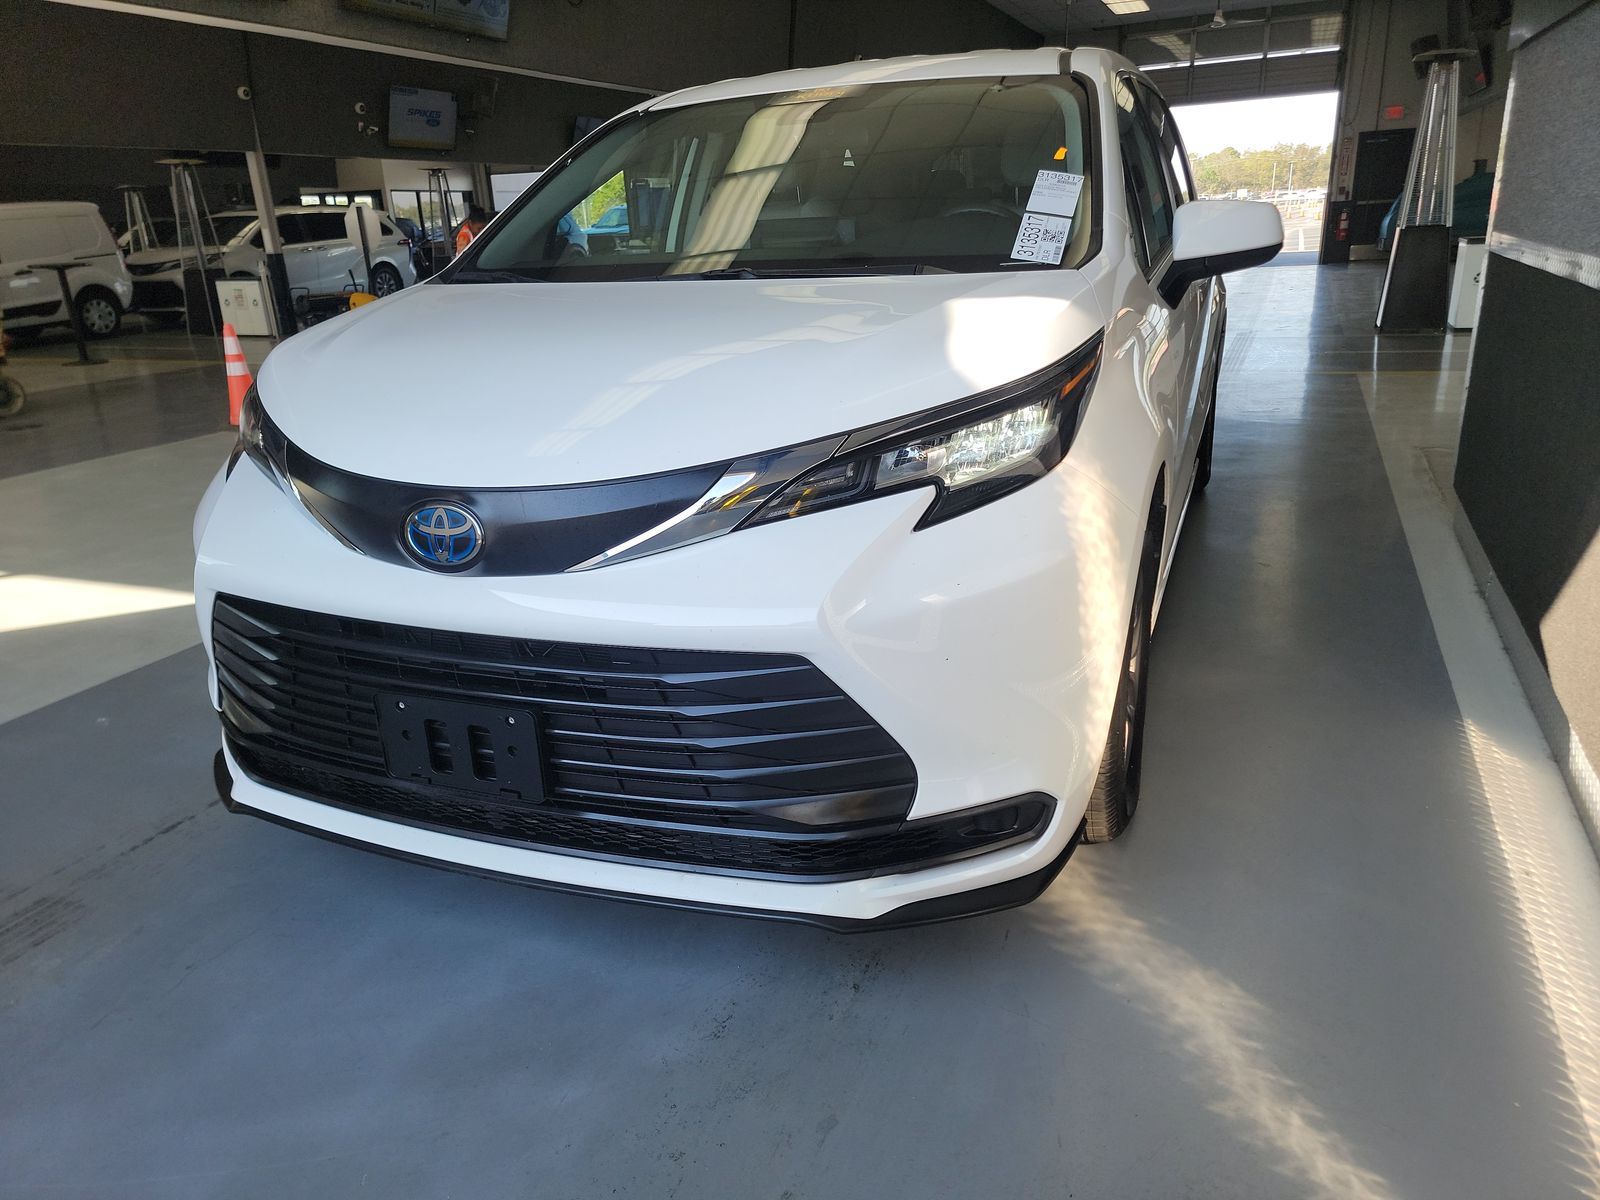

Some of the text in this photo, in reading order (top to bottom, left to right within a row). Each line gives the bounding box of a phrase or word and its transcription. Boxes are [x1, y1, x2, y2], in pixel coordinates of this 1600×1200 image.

[407, 107, 442, 119] SPIKES
[1038, 172, 1084, 184] 3135317
[1017, 216, 1045, 257] 3135317
